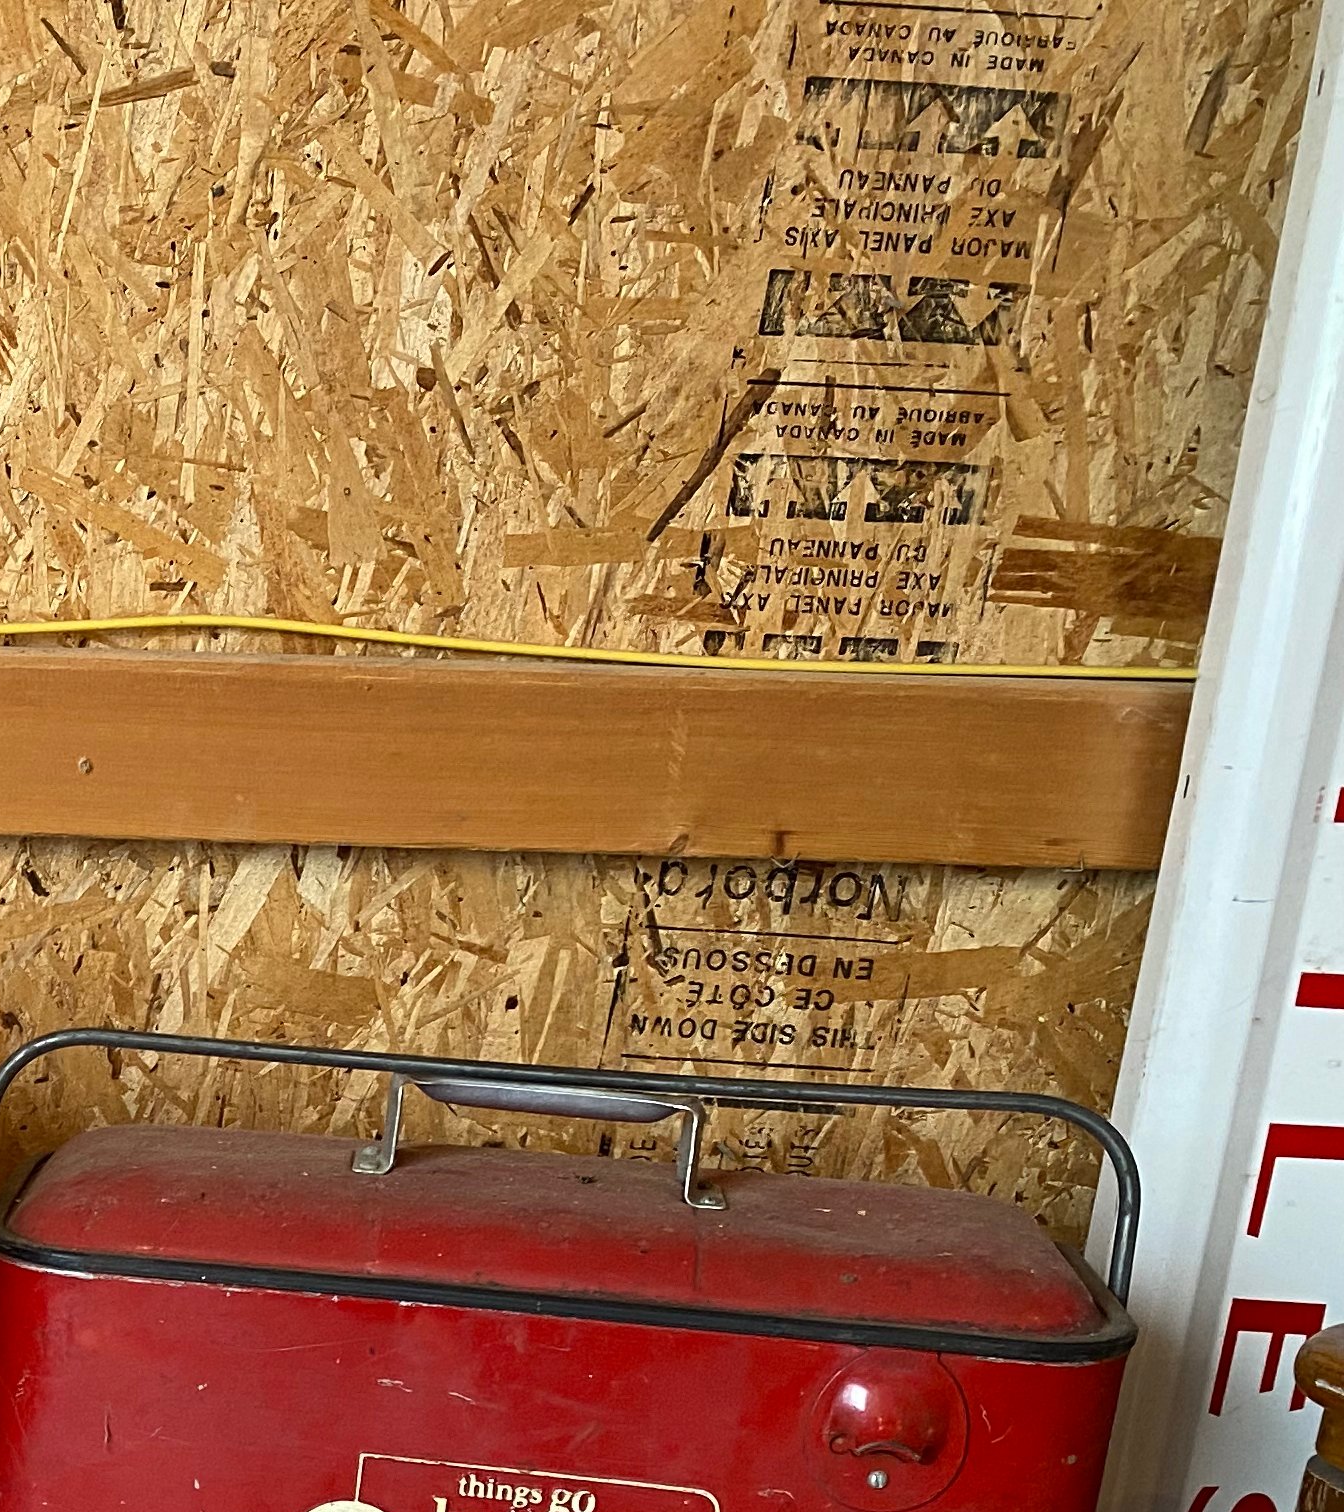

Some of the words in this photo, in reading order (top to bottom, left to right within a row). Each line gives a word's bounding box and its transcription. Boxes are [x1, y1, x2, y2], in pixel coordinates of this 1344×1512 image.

[928, 26, 956, 47] AU
[950, 51, 971, 70] IN
[986, 53, 1045, 73] MADE
[838, 169, 951, 193] PANNEAU
[971, 207, 1017, 229] AXE
[785, 225, 840, 245] AXIS
[857, 231, 933, 254] PANEL
[950, 235, 1033, 260] MAJOR
[853, 405, 880, 421] AU
[775, 424, 860, 443] CANADA
[874, 430, 895, 446] IN
[910, 431, 966, 447] MADE
[768, 537, 880, 561] PANNEAU
[896, 572, 942, 591] AXE
[786, 595, 862, 615] PANEL
[662, 947, 817, 977] DESSOUS
[834, 957, 874, 980] EN
[795, 988, 834, 1011] CE
[630, 1014, 718, 1040] DOWN
[731, 1019, 797, 1046] SIDE
[811, 1026, 876, 1050] THIS
[457, 1472, 544, 1510] things
